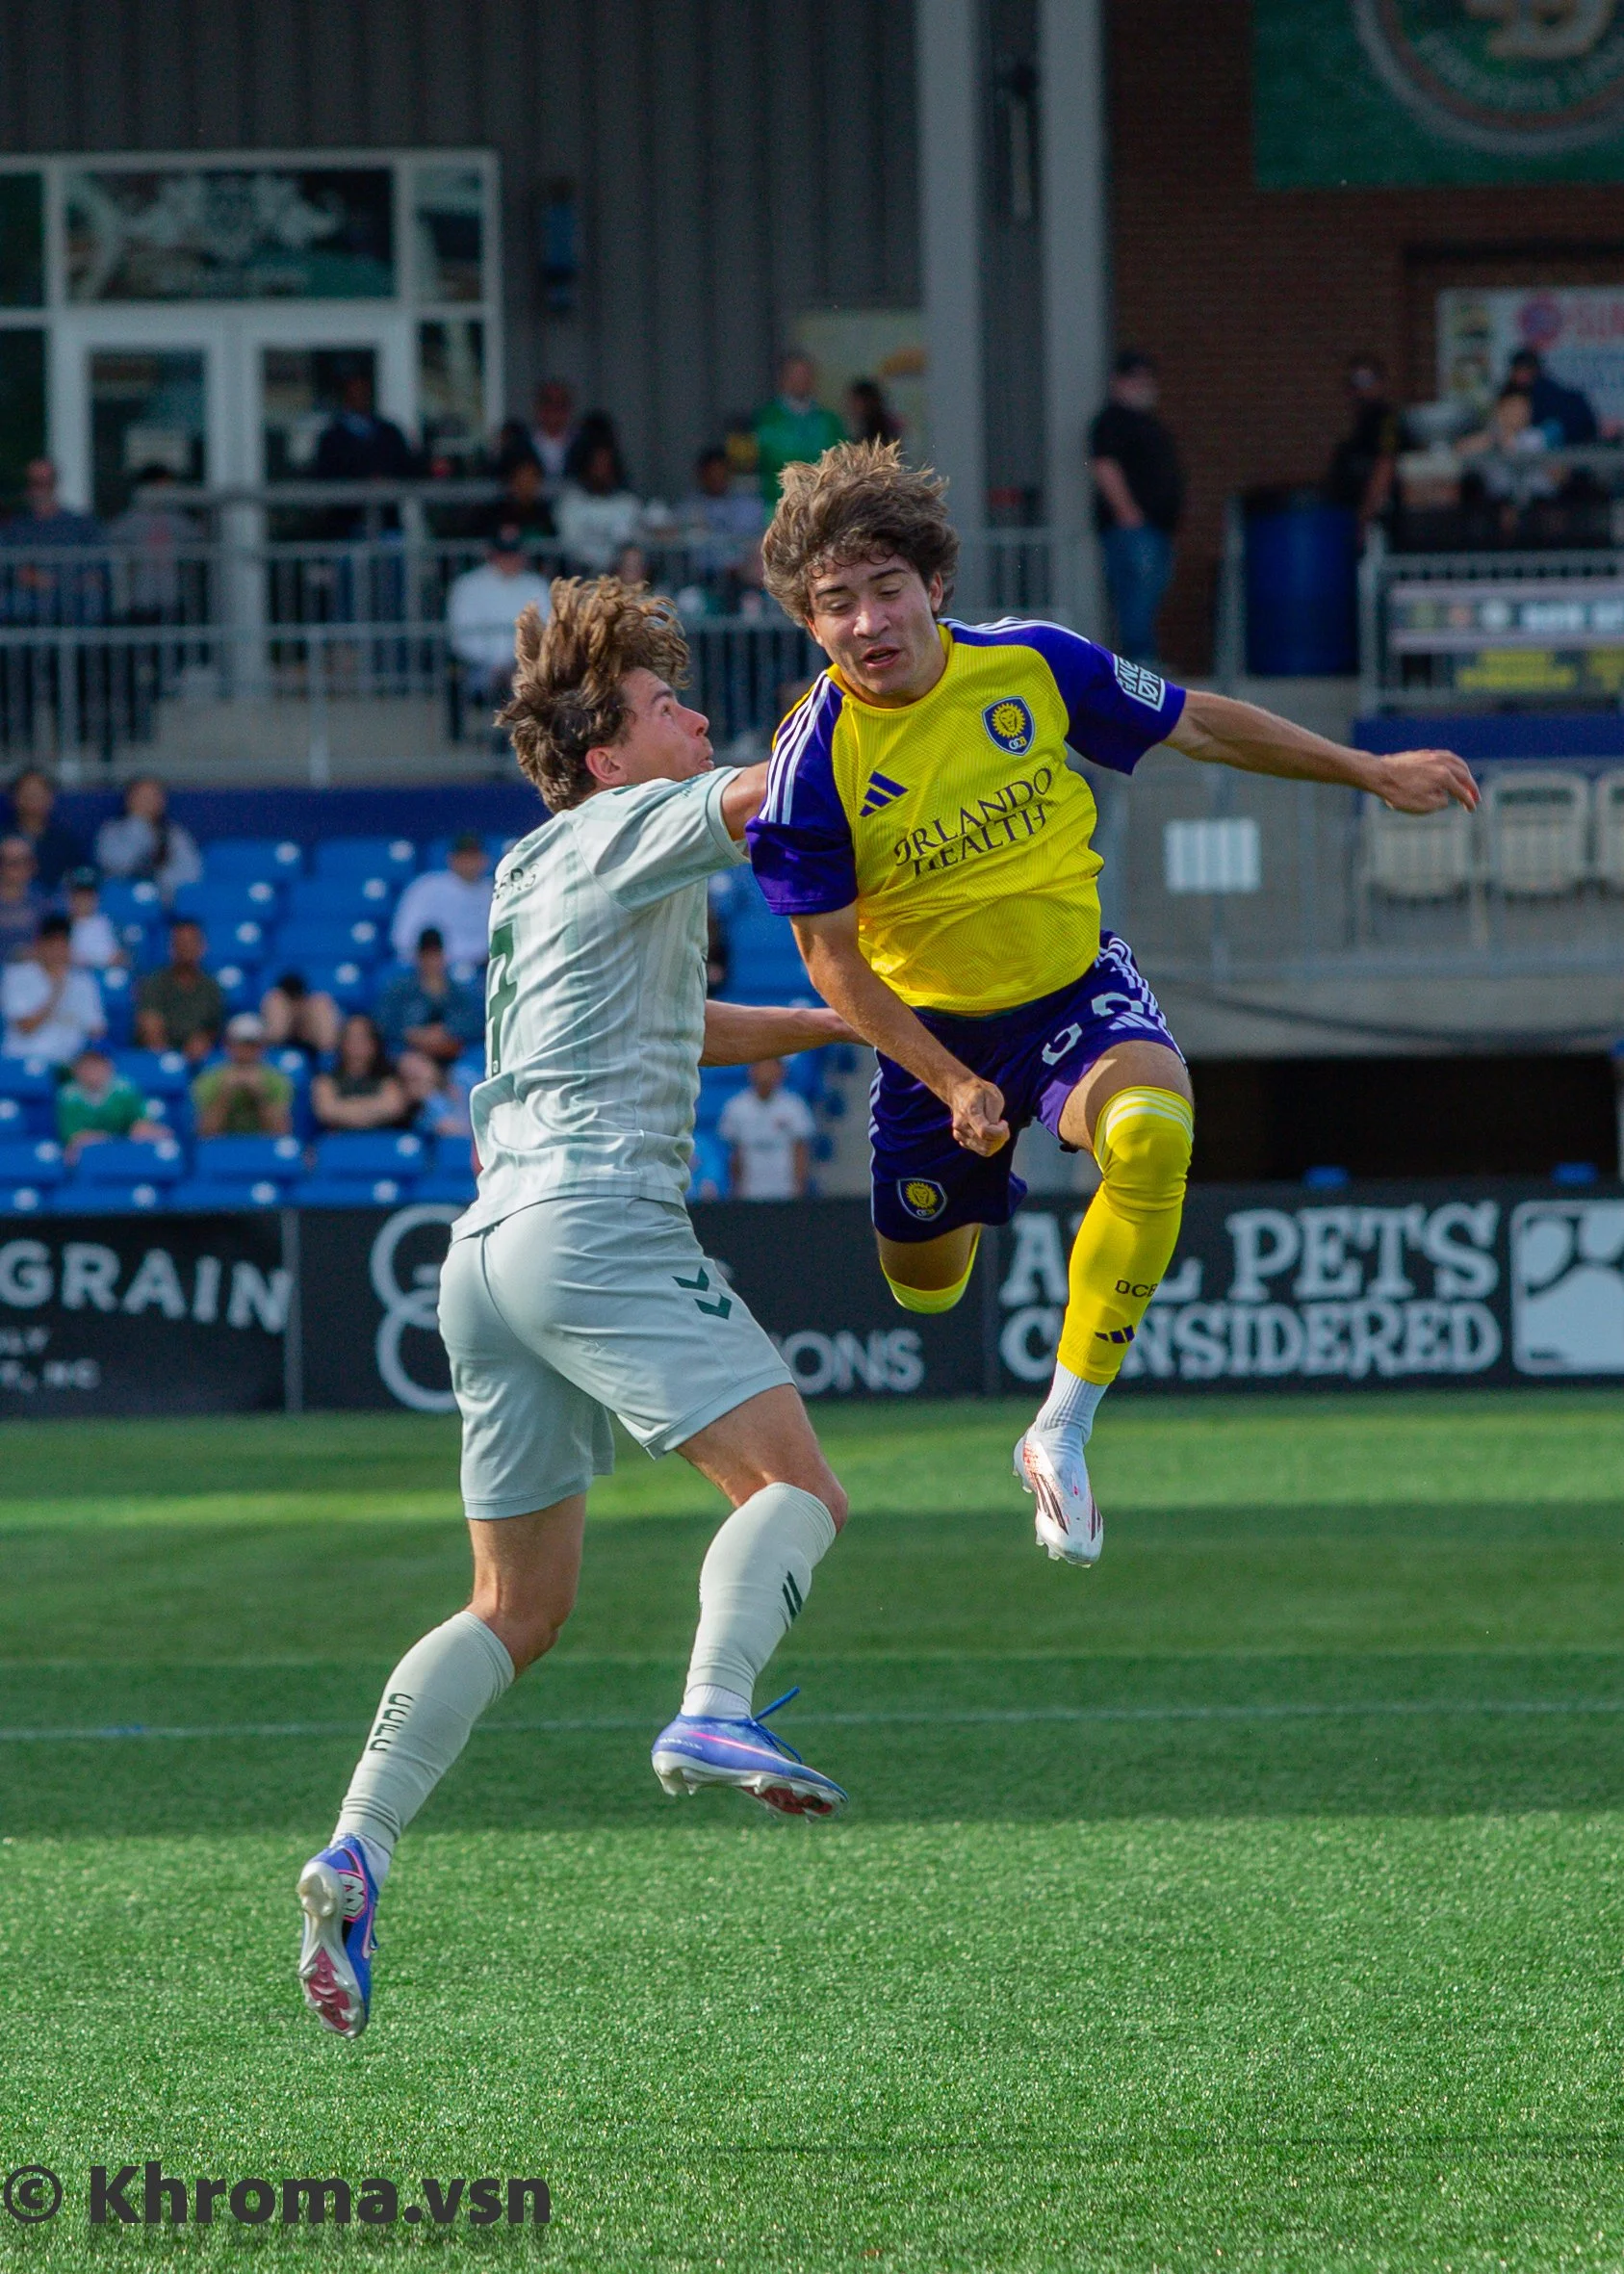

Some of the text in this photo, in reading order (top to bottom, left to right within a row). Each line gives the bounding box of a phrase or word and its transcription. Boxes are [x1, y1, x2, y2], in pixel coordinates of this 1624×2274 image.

[893, 767, 1053, 866] ORLANDO
[913, 803, 1048, 877] HEALTH
[0, 1238, 294, 1334] GRAIN
[1224, 1201, 1501, 1302] PETS
[999, 1300, 1504, 1382] CNSIDERED
